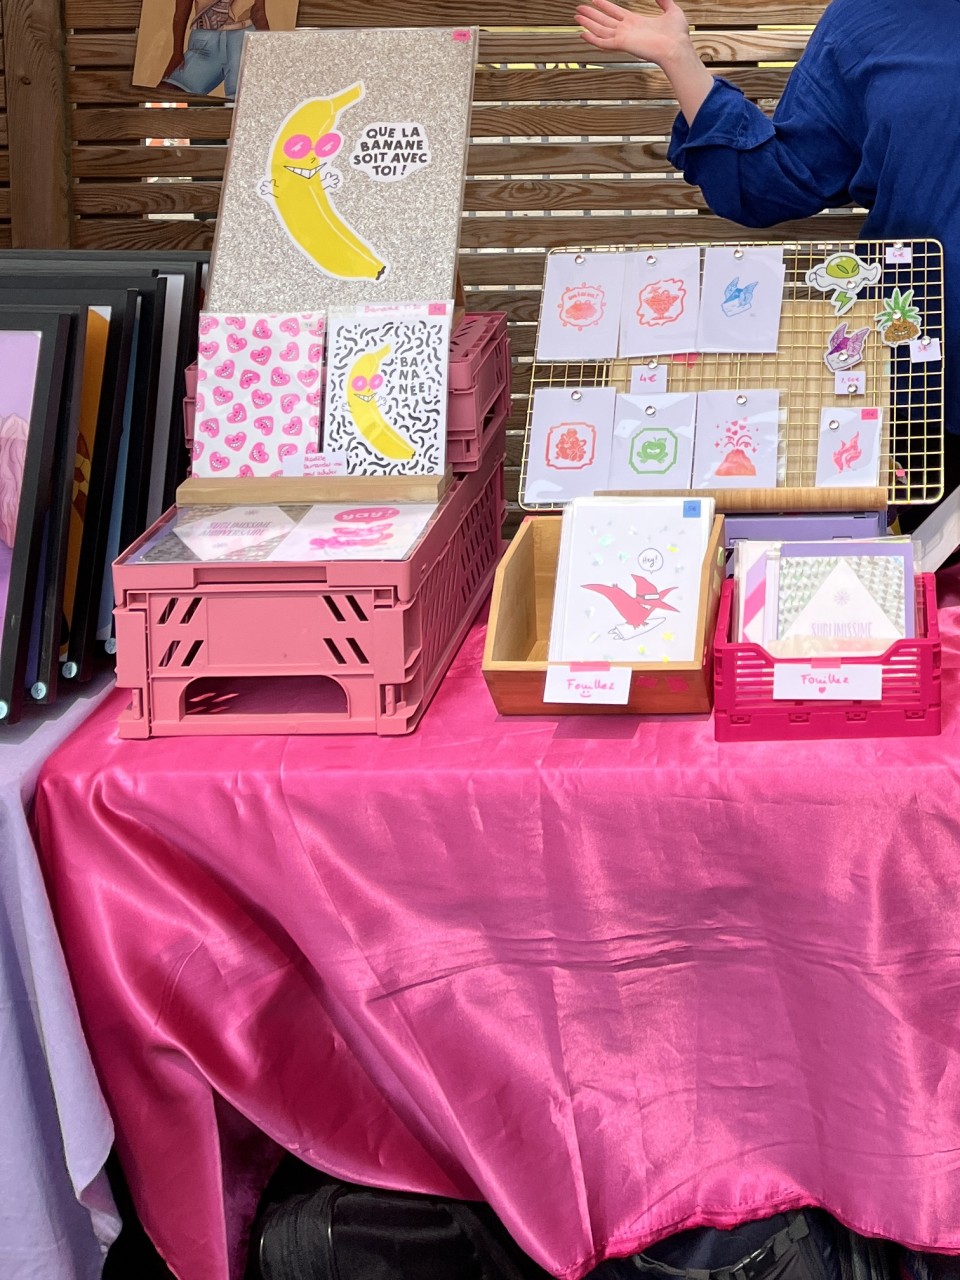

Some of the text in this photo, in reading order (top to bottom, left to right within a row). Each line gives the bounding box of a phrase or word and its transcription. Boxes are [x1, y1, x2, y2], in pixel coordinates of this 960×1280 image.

[366, 126, 420, 139] QUE LA
[360, 139, 424, 152] BANANE
[353, 152, 428, 165] SOIT AVEC
[372, 164, 397, 176] TOI
[400, 356, 419, 368] BA
[399, 369, 420, 381] NA
[643, 554, 658, 568] Hey!
[566, 678, 615, 690] Fouillez
[800, 672, 849, 685] Fouillez
